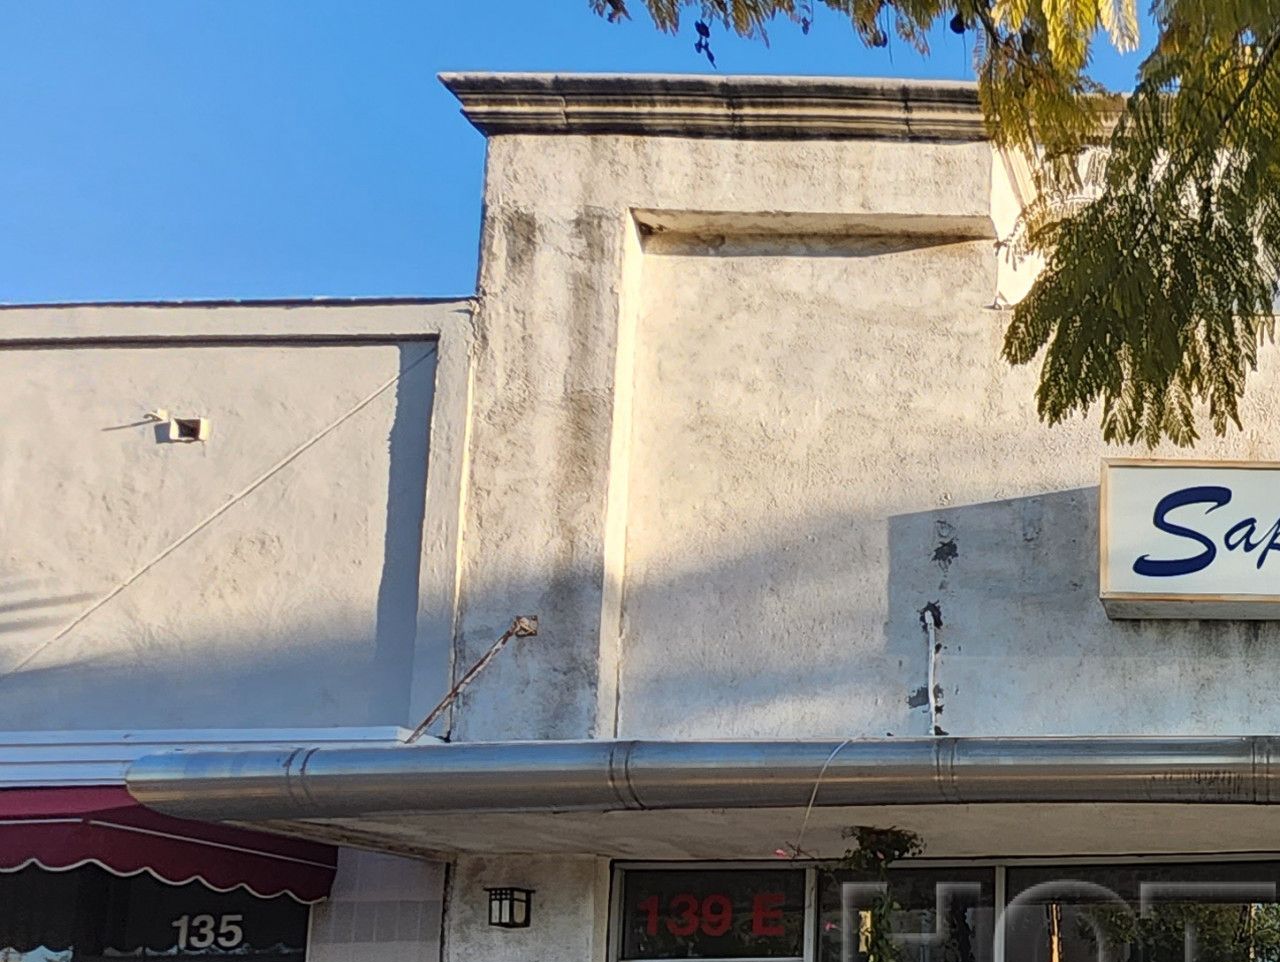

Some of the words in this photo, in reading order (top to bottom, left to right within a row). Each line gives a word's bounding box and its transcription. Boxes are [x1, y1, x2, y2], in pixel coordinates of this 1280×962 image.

[171, 914, 243, 950] 135
[638, 893, 734, 937] 139
[752, 892, 785, 937] E
